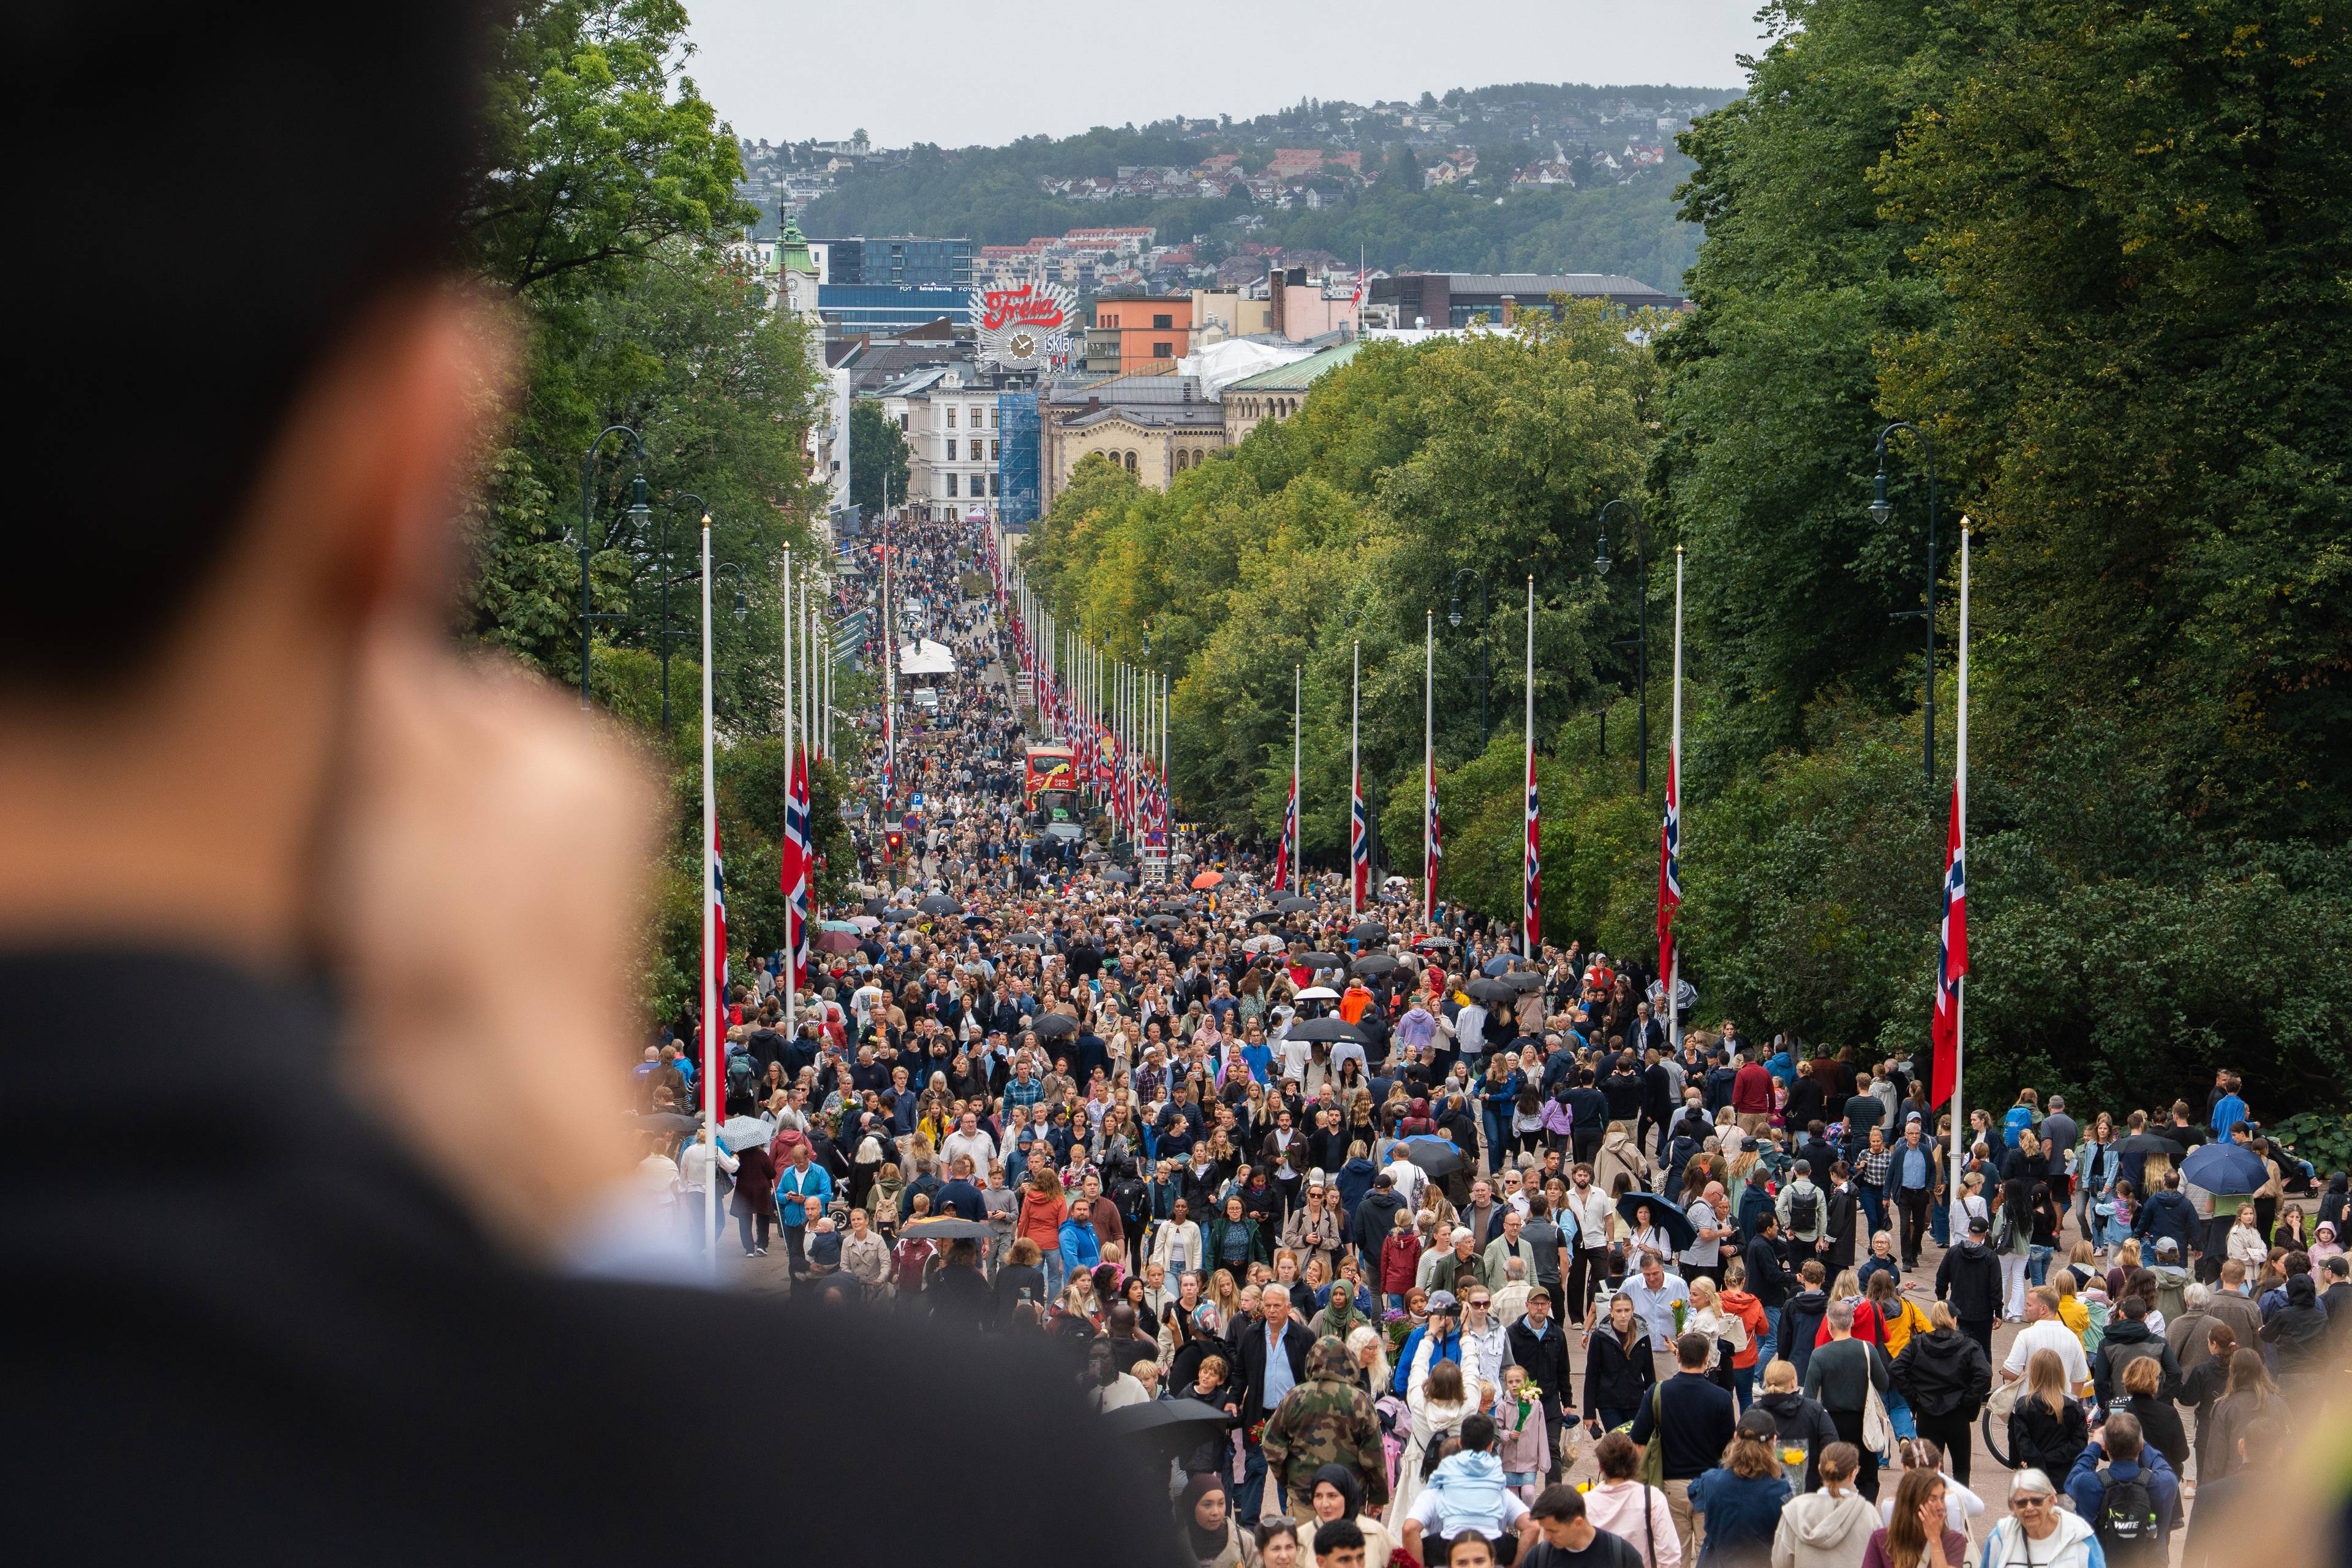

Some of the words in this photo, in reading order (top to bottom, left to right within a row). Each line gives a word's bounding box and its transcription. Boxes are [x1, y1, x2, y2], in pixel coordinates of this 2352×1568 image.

[983, 284, 1064, 330] Freia
[1045, 333, 1074, 352] isklar
[914, 794, 921, 804] P
